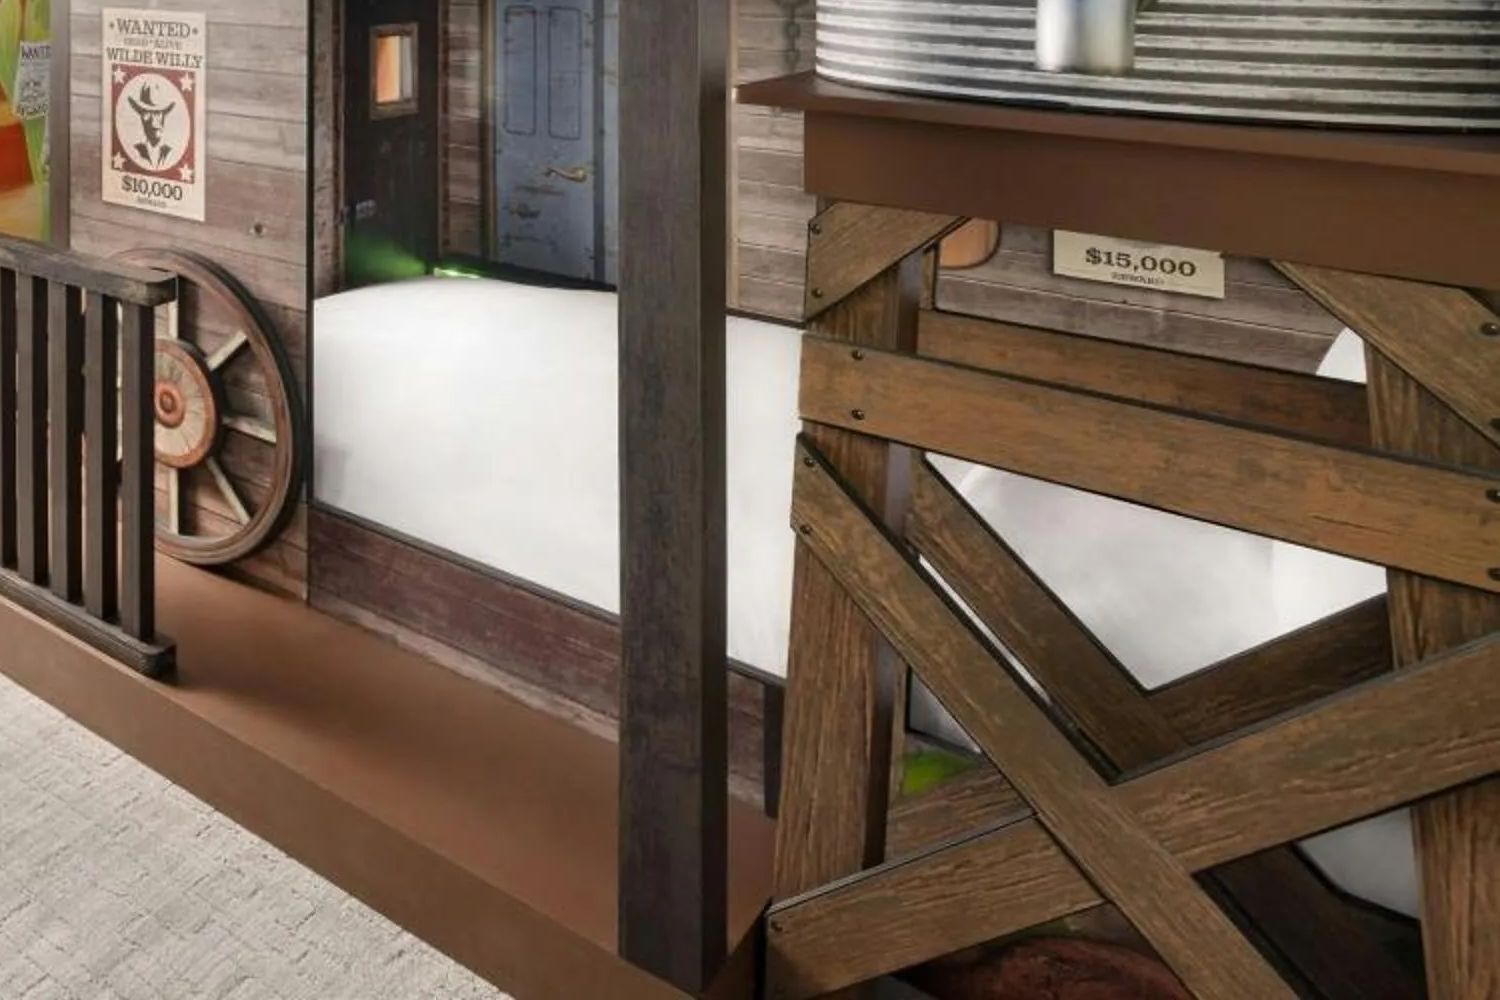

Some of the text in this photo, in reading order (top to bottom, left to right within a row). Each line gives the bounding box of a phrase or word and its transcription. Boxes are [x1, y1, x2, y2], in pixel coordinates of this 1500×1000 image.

[116, 18, 191, 38] WANTED
[106, 47, 203, 69] WILDE WILLY
[121, 175, 183, 201] $10,000
[1085, 247, 1197, 277] $15,000
